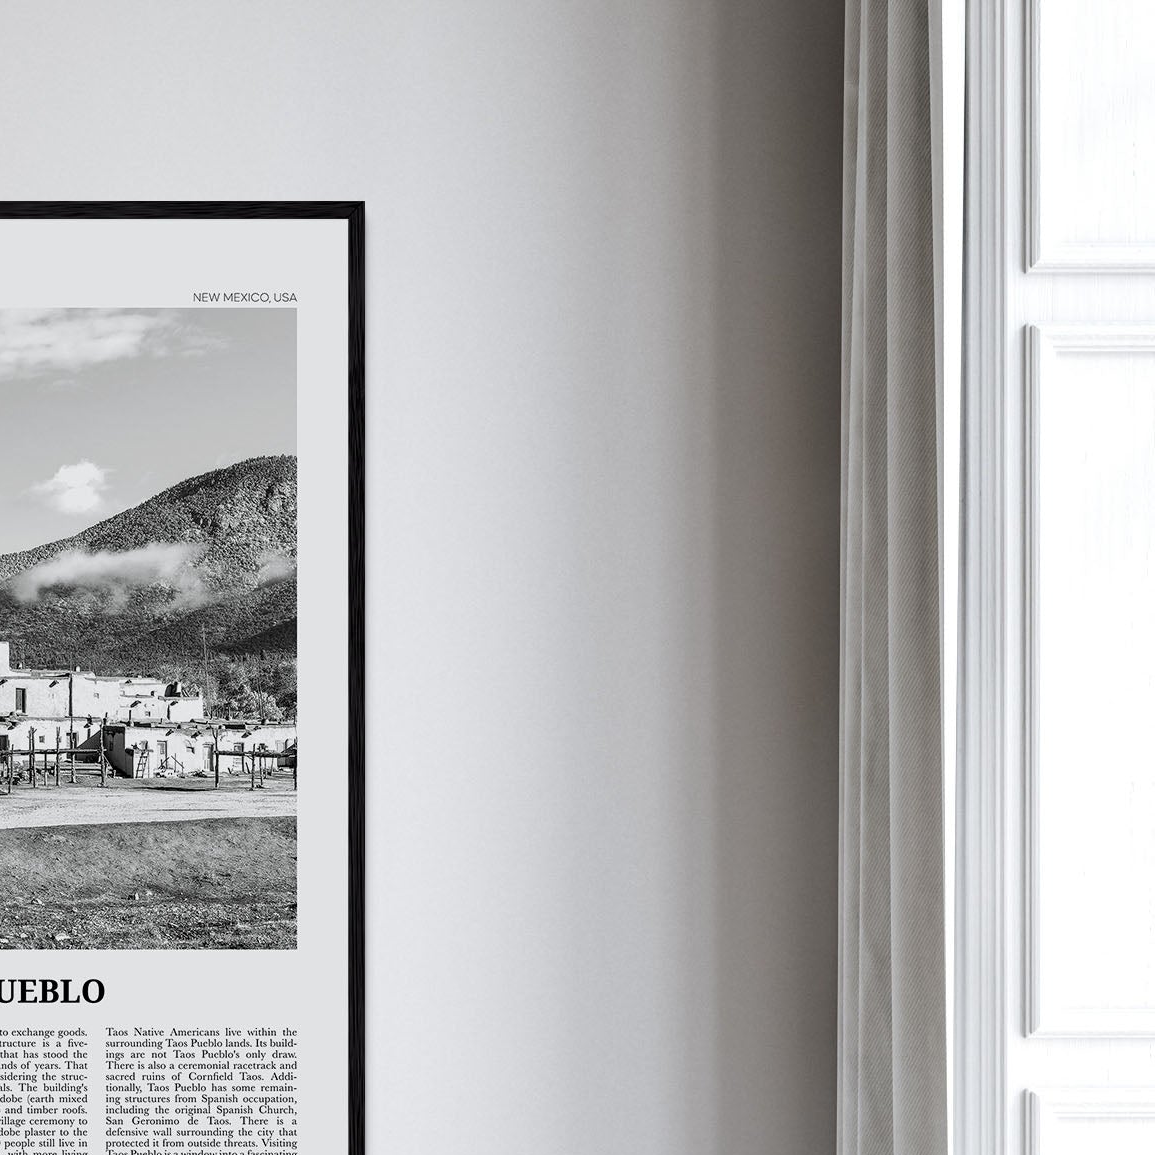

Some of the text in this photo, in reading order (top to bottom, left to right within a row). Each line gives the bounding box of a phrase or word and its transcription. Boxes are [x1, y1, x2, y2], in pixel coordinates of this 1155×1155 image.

[193, 292, 298, 304] NEW MEXICO, USA
[11, 1028, 55, 1038] exchange
[57, 1028, 88, 1038] goods.
[106, 1028, 298, 1036] Taos Native Americans live within the
[105, 1039, 297, 1049] surrounding Taos Pueblo lands. Its build-
[41, 1072, 57, 1081] the
[61, 1072, 88, 1081] struc-
[105, 1072, 297, 1081] sacred ruins of Cornfield Taos. Addi-
[18, 1083, 38, 1092] The
[43, 1083, 88, 1094] building's
[105, 1083, 143, 1094] tionally,
[147, 1083, 170, 1092] Taos
[174, 1083, 207, 1092] Pueblo
[211, 1083, 227, 1092] has
[260, 1083, 297, 1092] remain-
[27, 1094, 55, 1105] (earth
[59, 1094, 88, 1103] mixed
[106, 1094, 298, 1105] ing structures from Spanish occupation,
[105, 1106, 298, 1116] including the original Spanish Church,
[105, 1128, 298, 1138] defensive wall surrounding the city that
[4, 1139, 36, 1149] people
[38, 1139, 55, 1147] still
[58, 1139, 75, 1147] live
[78, 1139, 88, 1147] in
[105, 1139, 298, 1149] protected it from outside threats. Visiting
